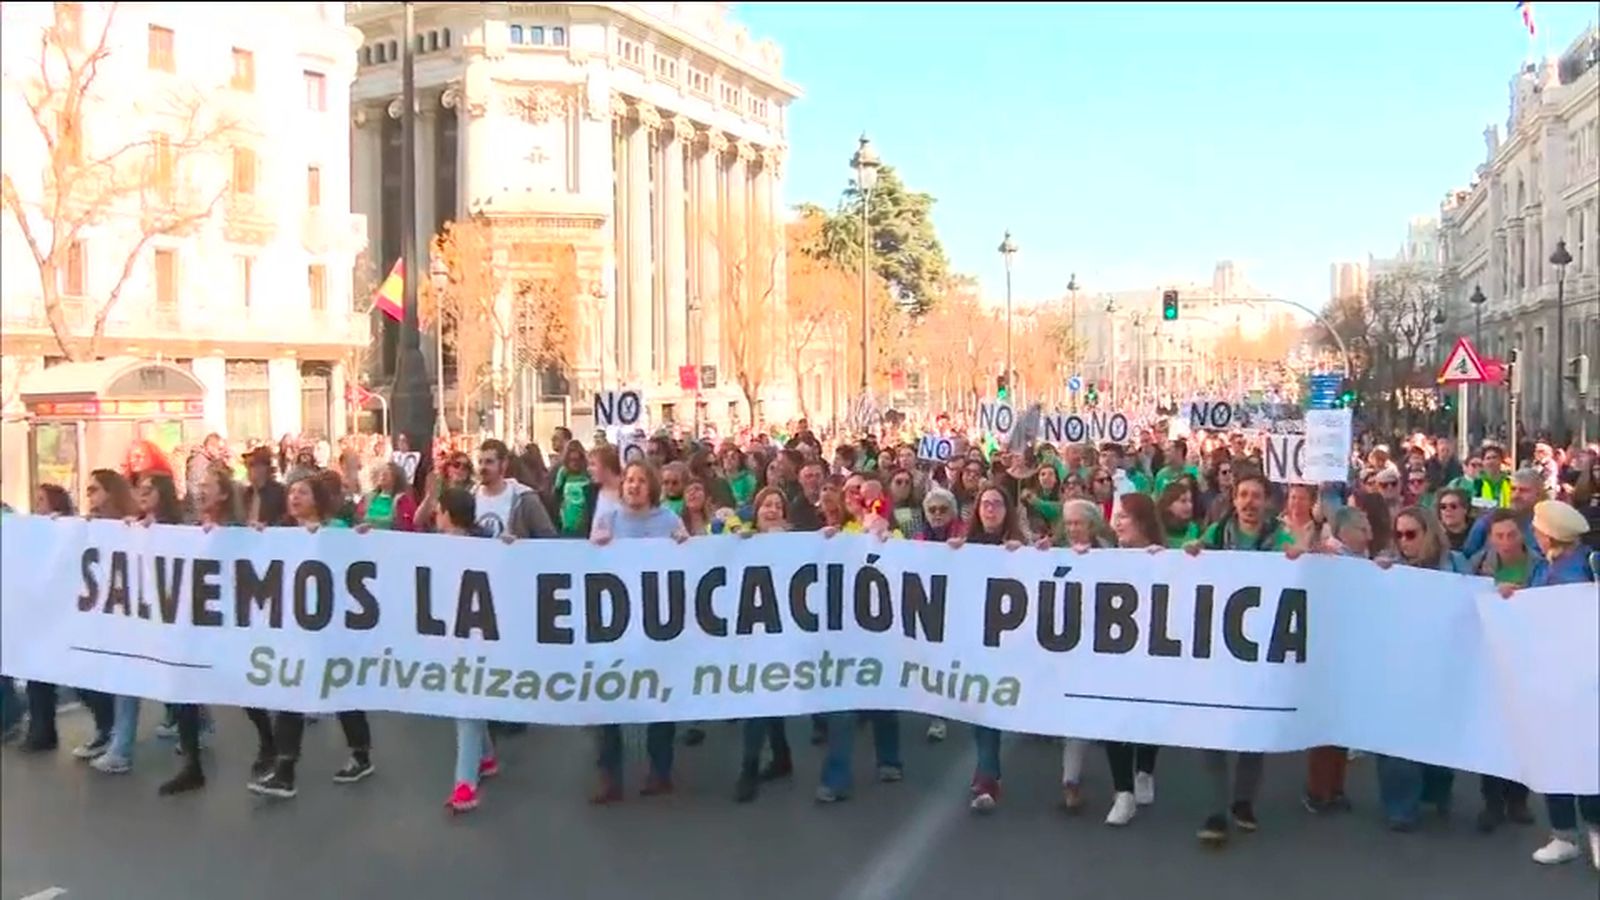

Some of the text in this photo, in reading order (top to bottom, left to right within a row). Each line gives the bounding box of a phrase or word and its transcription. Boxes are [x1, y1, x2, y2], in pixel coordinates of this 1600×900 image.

[594, 391, 640, 425] NO
[979, 403, 1013, 433] NO
[1045, 415, 1085, 442] NO
[1091, 411, 1128, 441] NO
[920, 436, 952, 460] NO
[78, 548, 1309, 664] SALVEMOS LA EDUCACIÓN PÚBLICA
[245, 645, 1022, 708] Su privatización, nuestra ruina
